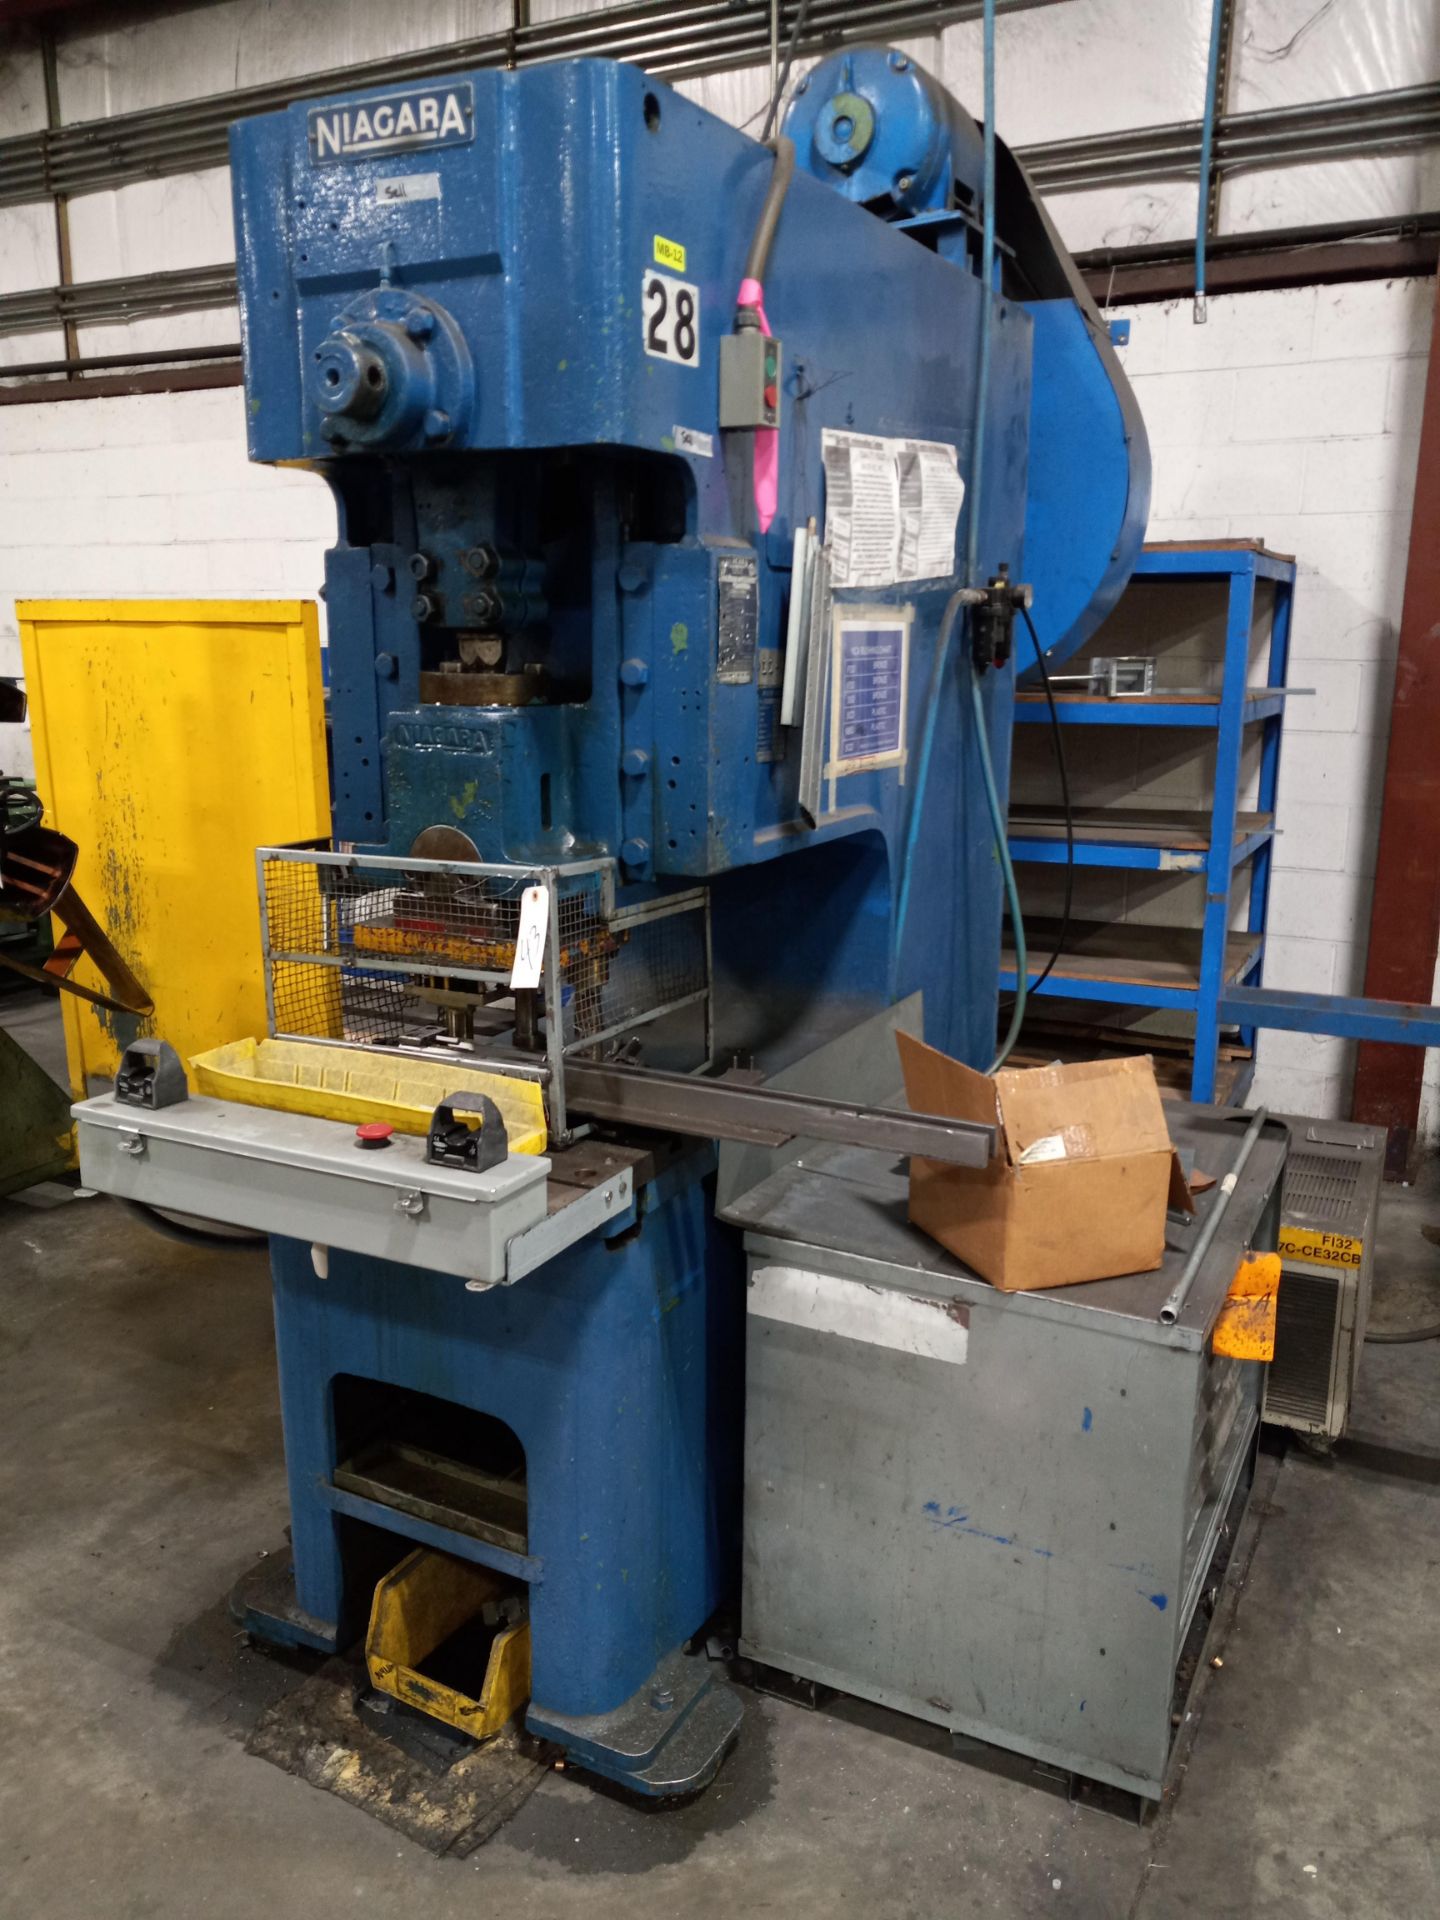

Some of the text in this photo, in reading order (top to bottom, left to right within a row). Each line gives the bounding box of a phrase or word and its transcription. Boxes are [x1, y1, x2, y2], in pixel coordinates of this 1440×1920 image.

[316, 93, 466, 157] NIAGARA
[384, 184, 407, 199] Sell
[656, 242, 683, 263] MB-12
[647, 278, 696, 360] 28
